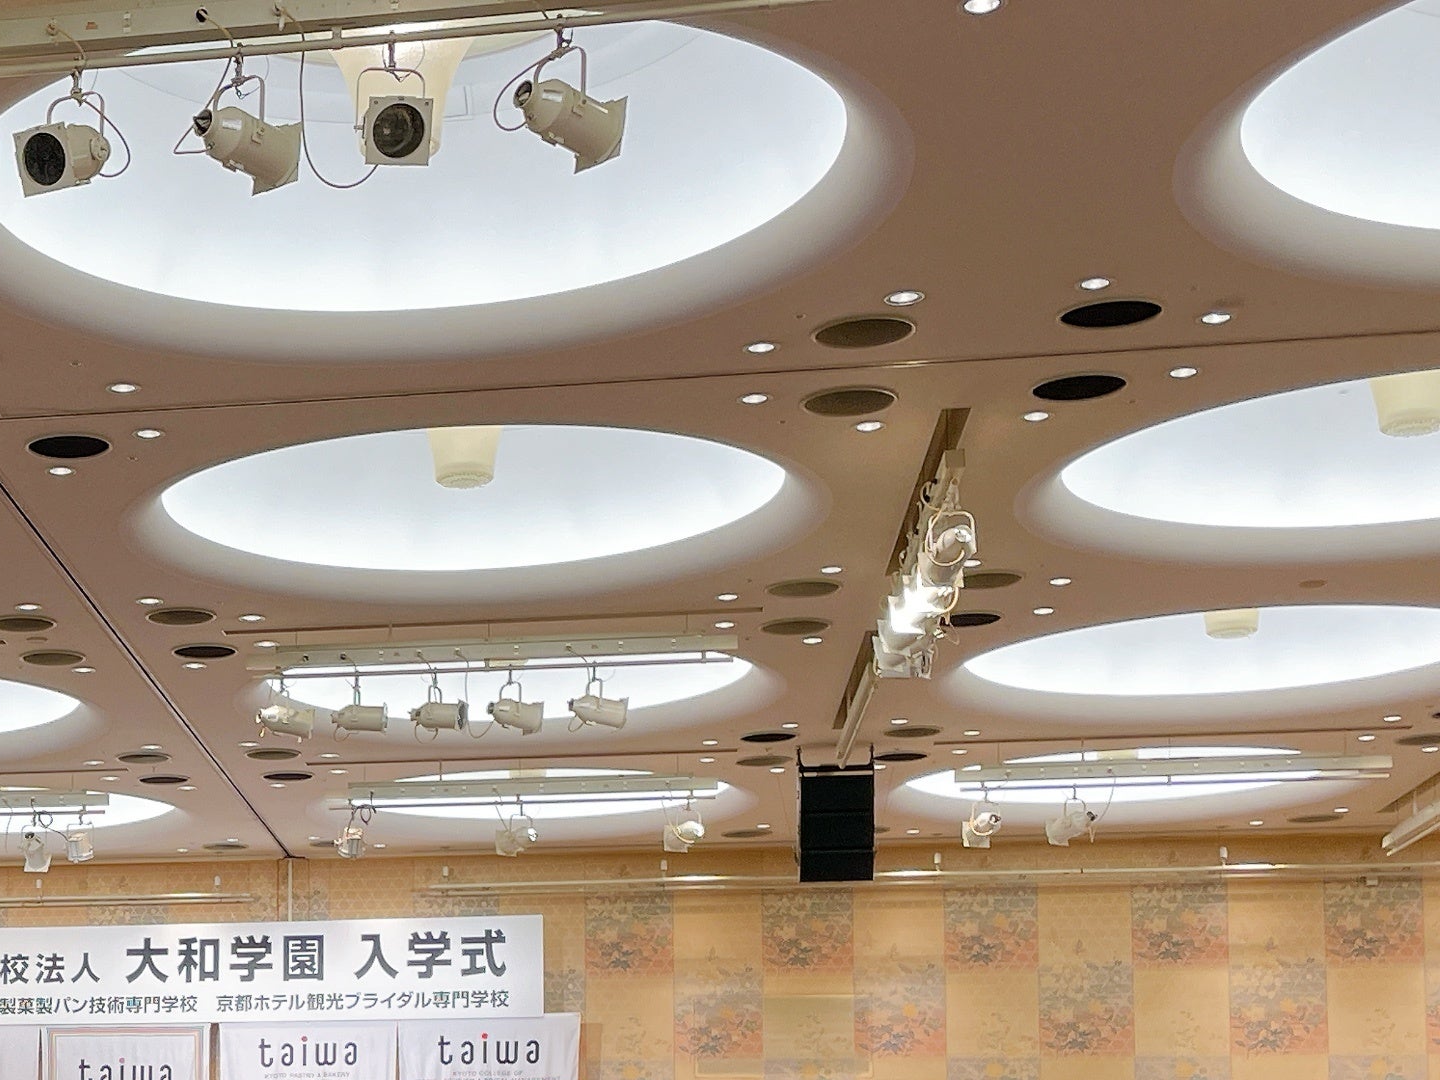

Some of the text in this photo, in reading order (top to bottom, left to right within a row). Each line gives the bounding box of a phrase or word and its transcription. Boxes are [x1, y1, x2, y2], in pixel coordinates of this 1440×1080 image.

[125, 934, 325, 984] 大和学園
[353, 929, 508, 981] 入学式
[216, 990, 510, 1012] 京都ホテル観光ブライダル専門学校
[258, 1036, 357, 1068] taiwa
[438, 1032, 540, 1066] taiwa
